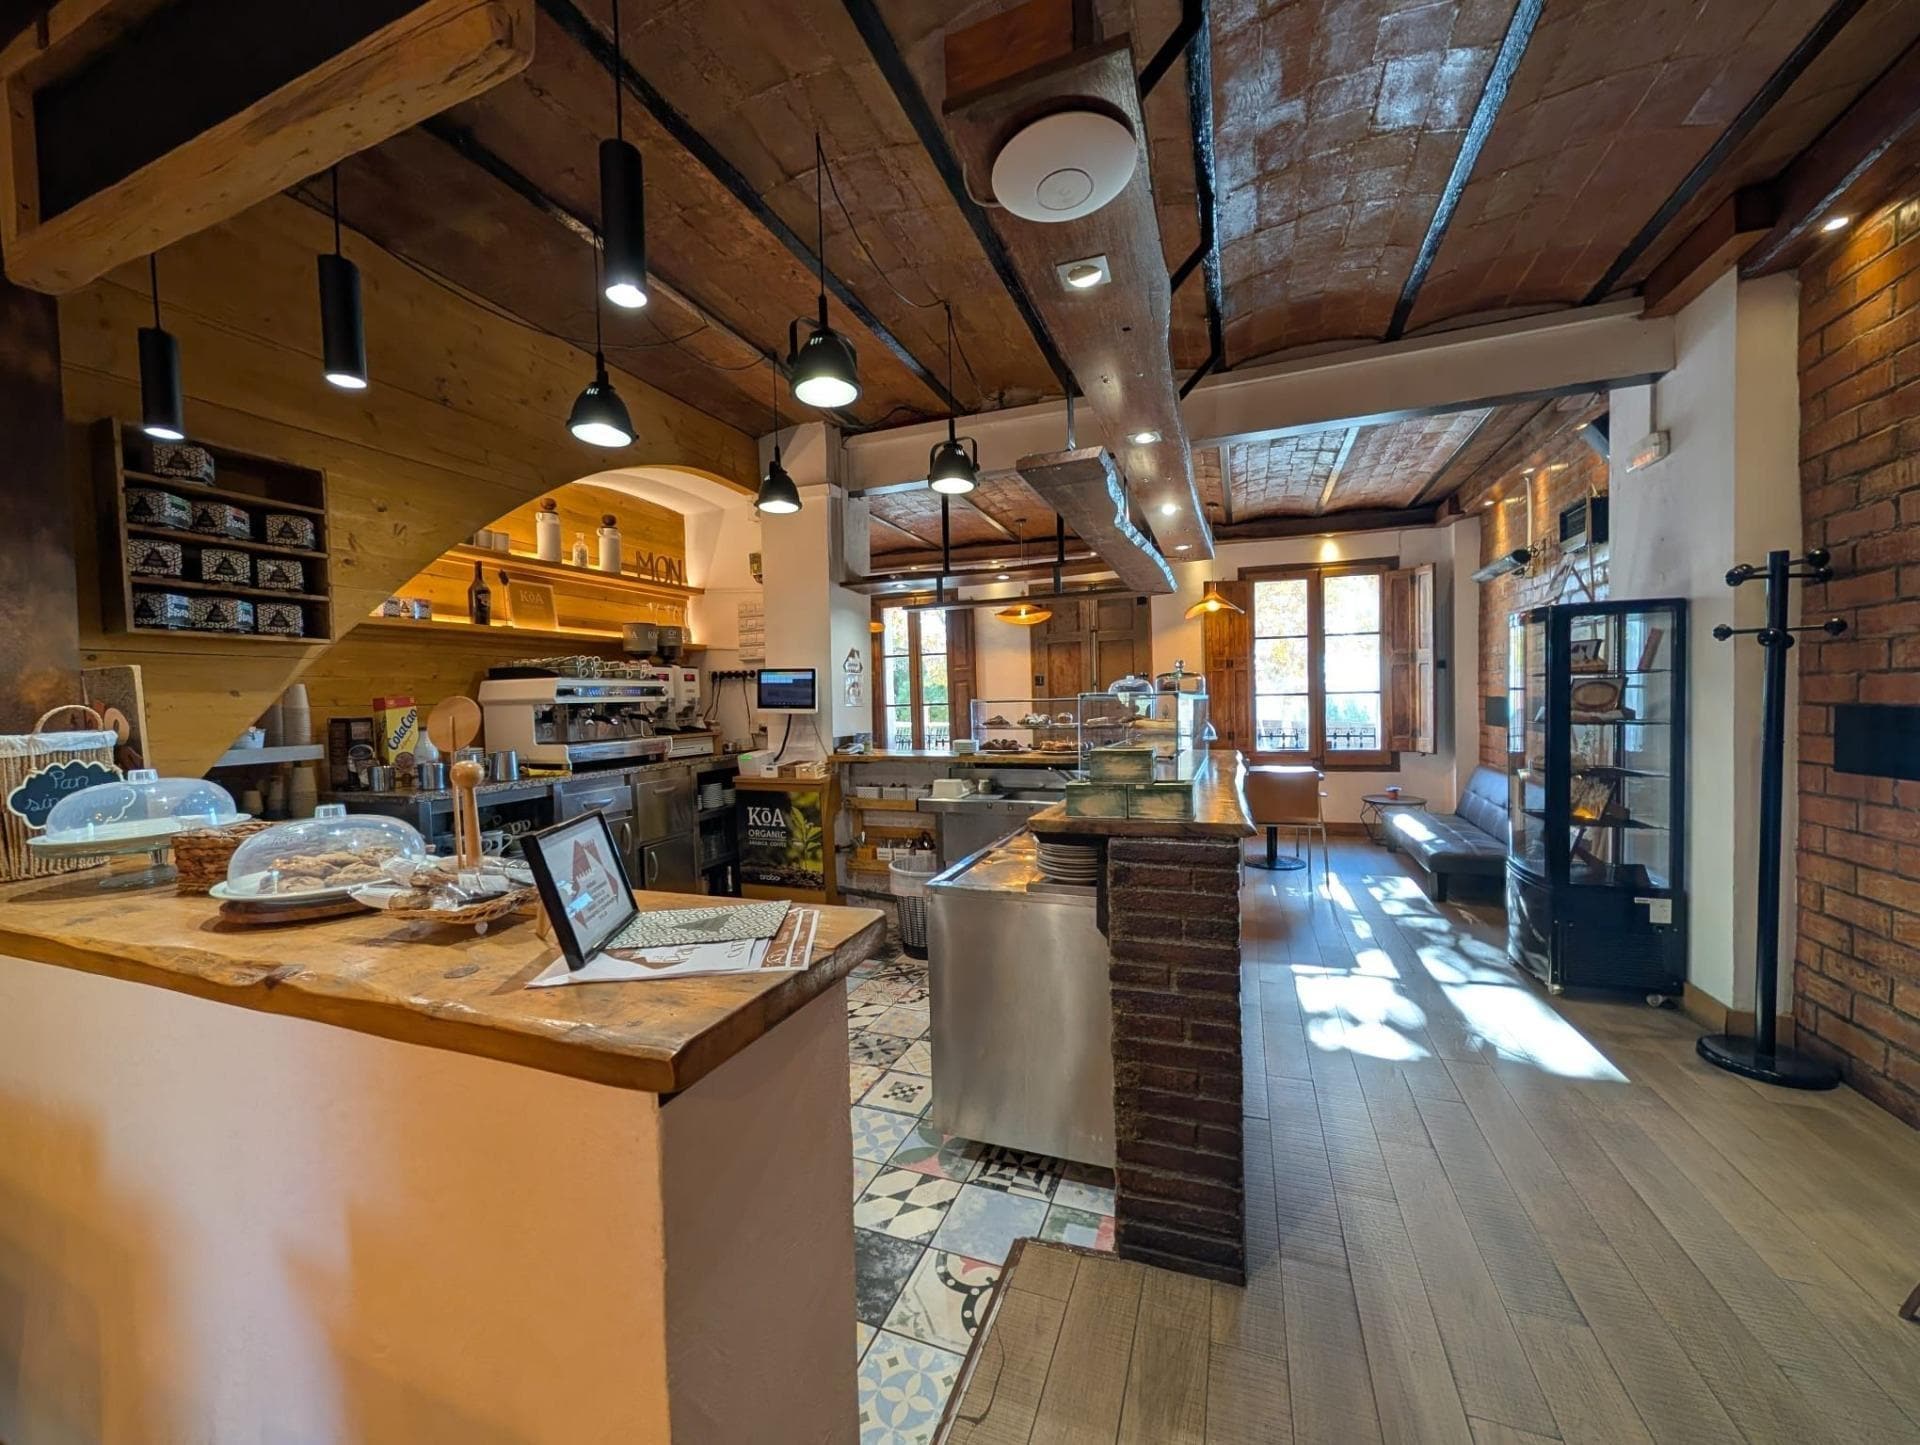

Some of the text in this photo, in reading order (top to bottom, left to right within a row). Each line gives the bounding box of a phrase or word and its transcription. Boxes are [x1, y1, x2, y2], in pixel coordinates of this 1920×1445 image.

[635, 551, 682, 587] MON
[387, 708, 417, 750] ColaCao
[49, 771, 89, 789] Pan
[748, 829, 787, 839] ORGANIC
